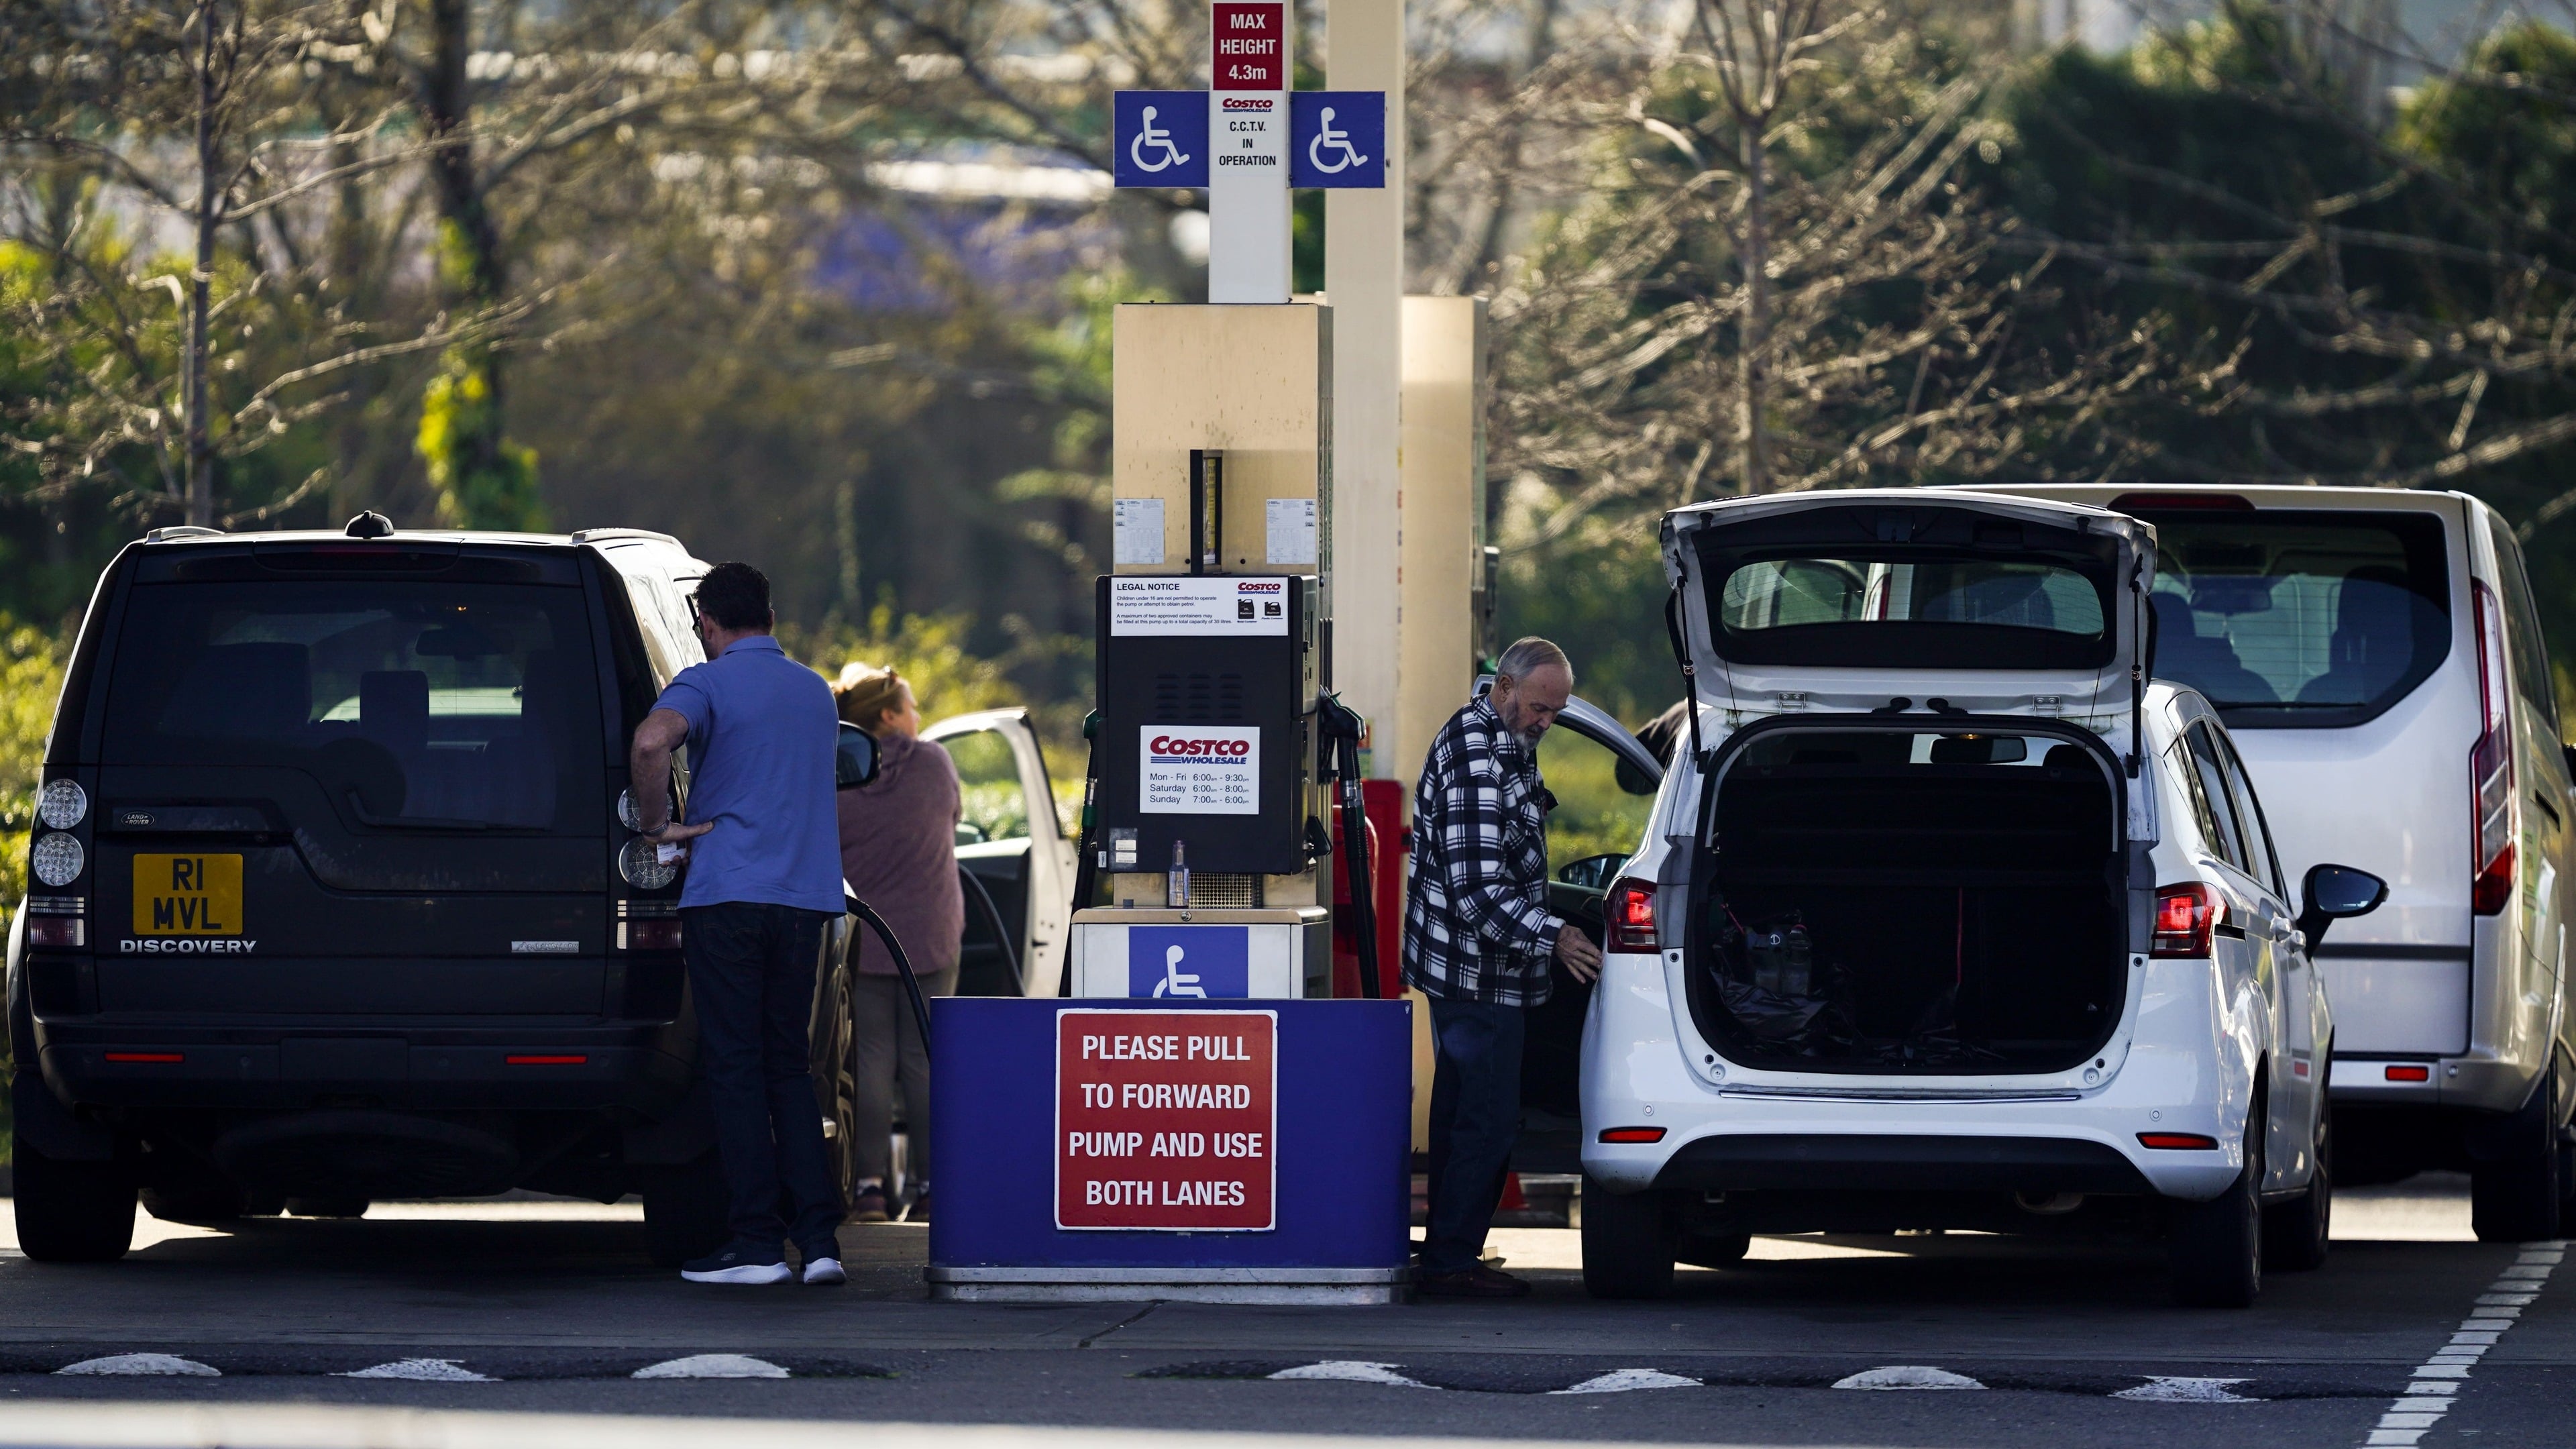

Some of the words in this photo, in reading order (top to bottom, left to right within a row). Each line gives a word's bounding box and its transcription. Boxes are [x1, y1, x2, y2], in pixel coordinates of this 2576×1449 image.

[1230, 13, 1266, 30] MAX
[1220, 39, 1276, 54] HEIGHT
[1228, 65, 1267, 80] 4.3m
[1230, 121, 1266, 131] C.C.T.V.
[1242, 138, 1253, 148] IN
[1219, 155, 1276, 166] OPERATION
[1181, 756, 1247, 765] WHOLESALE
[1150, 784, 1187, 794] Saturday
[1150, 795, 1181, 804] Sunday
[153, 898, 222, 930] MVL
[120, 940, 256, 953] DISCOVERY
[1083, 1035, 1179, 1060] PLEASE
[1187, 1036, 1250, 1061] PULL
[1081, 1083, 1114, 1108] TO
[1122, 1083, 1250, 1109] FORWARD
[1069, 1132, 1143, 1157] PUMP
[1150, 1132, 1205, 1157] AND
[1214, 1133, 1263, 1157] USE
[1086, 1181, 1152, 1205] BOTH
[1162, 1181, 1245, 1205] LANES
